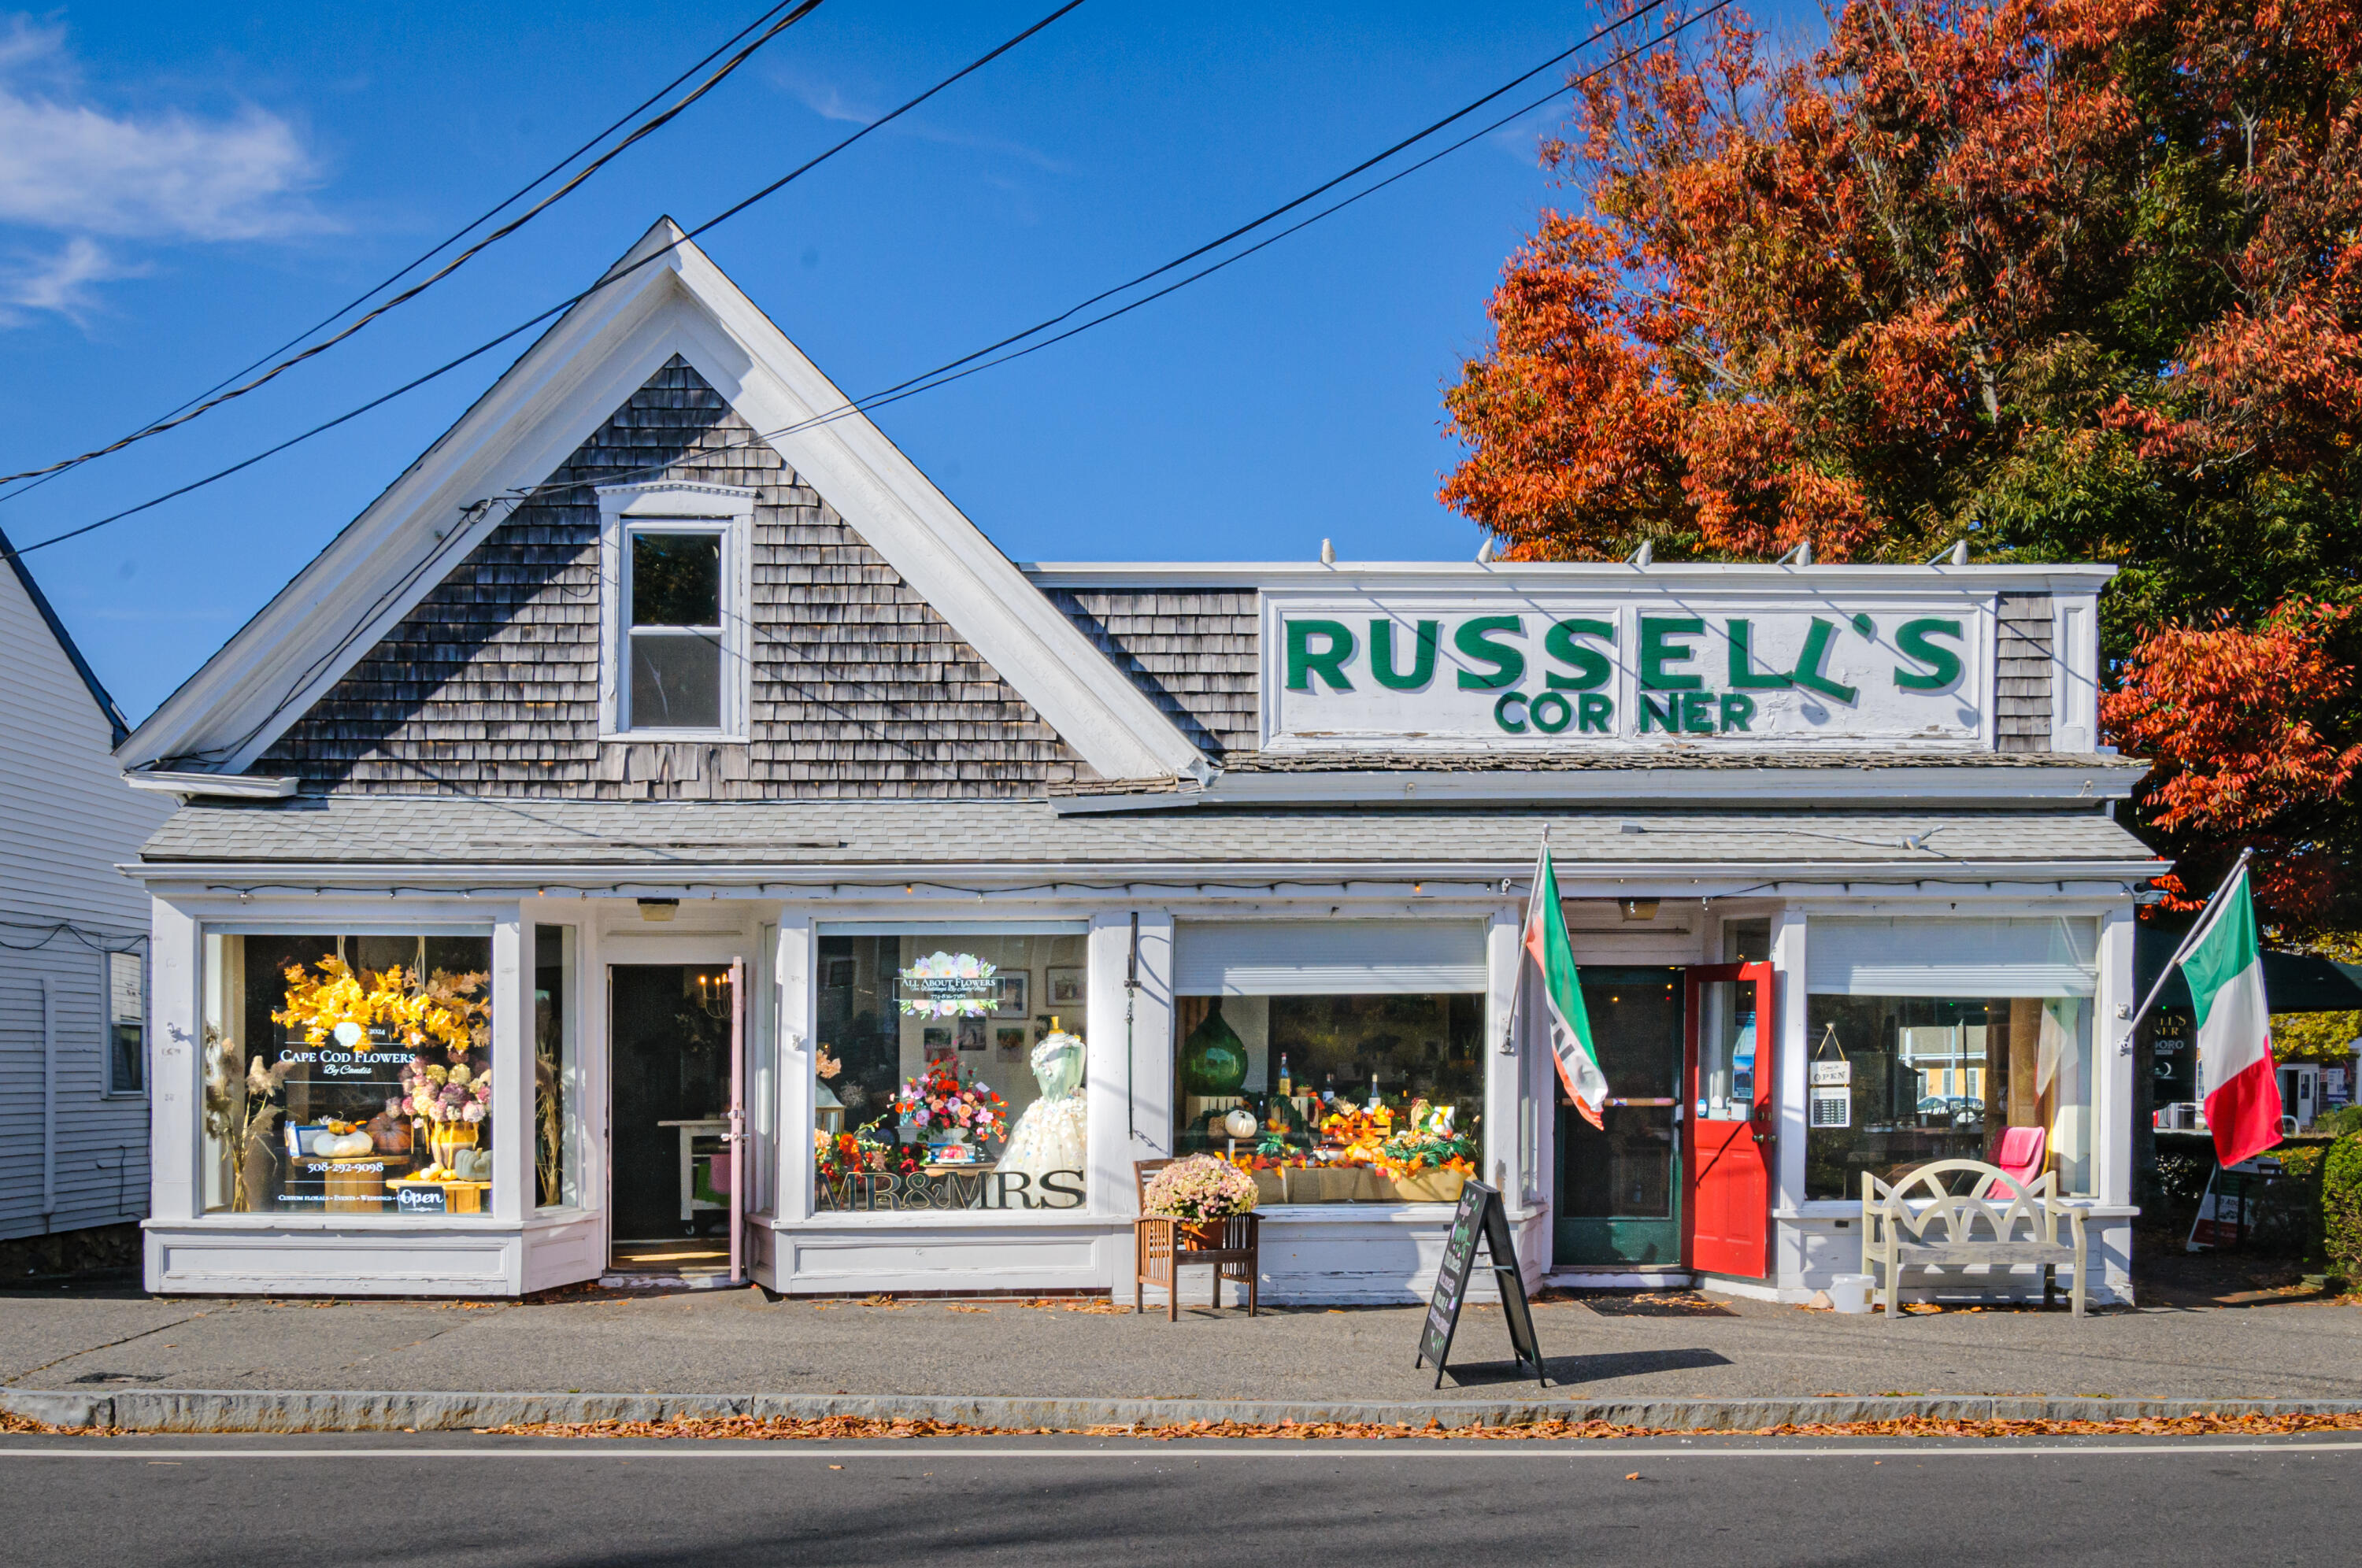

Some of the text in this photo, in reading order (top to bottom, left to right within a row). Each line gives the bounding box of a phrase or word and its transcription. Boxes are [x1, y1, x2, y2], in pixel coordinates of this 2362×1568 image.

[1283, 613, 1961, 704] RUSSELL'S
[1493, 690, 1755, 734] CORNER
[901, 977, 996, 987] ALL ABOUT FLOWERS
[279, 1049, 416, 1063] CAPE COD FLOWERS
[324, 1063, 339, 1076] By
[1813, 1071, 1846, 1082] OPEN
[307, 1162, 384, 1174] 508-292-9098
[401, 1189, 444, 1207] Open
